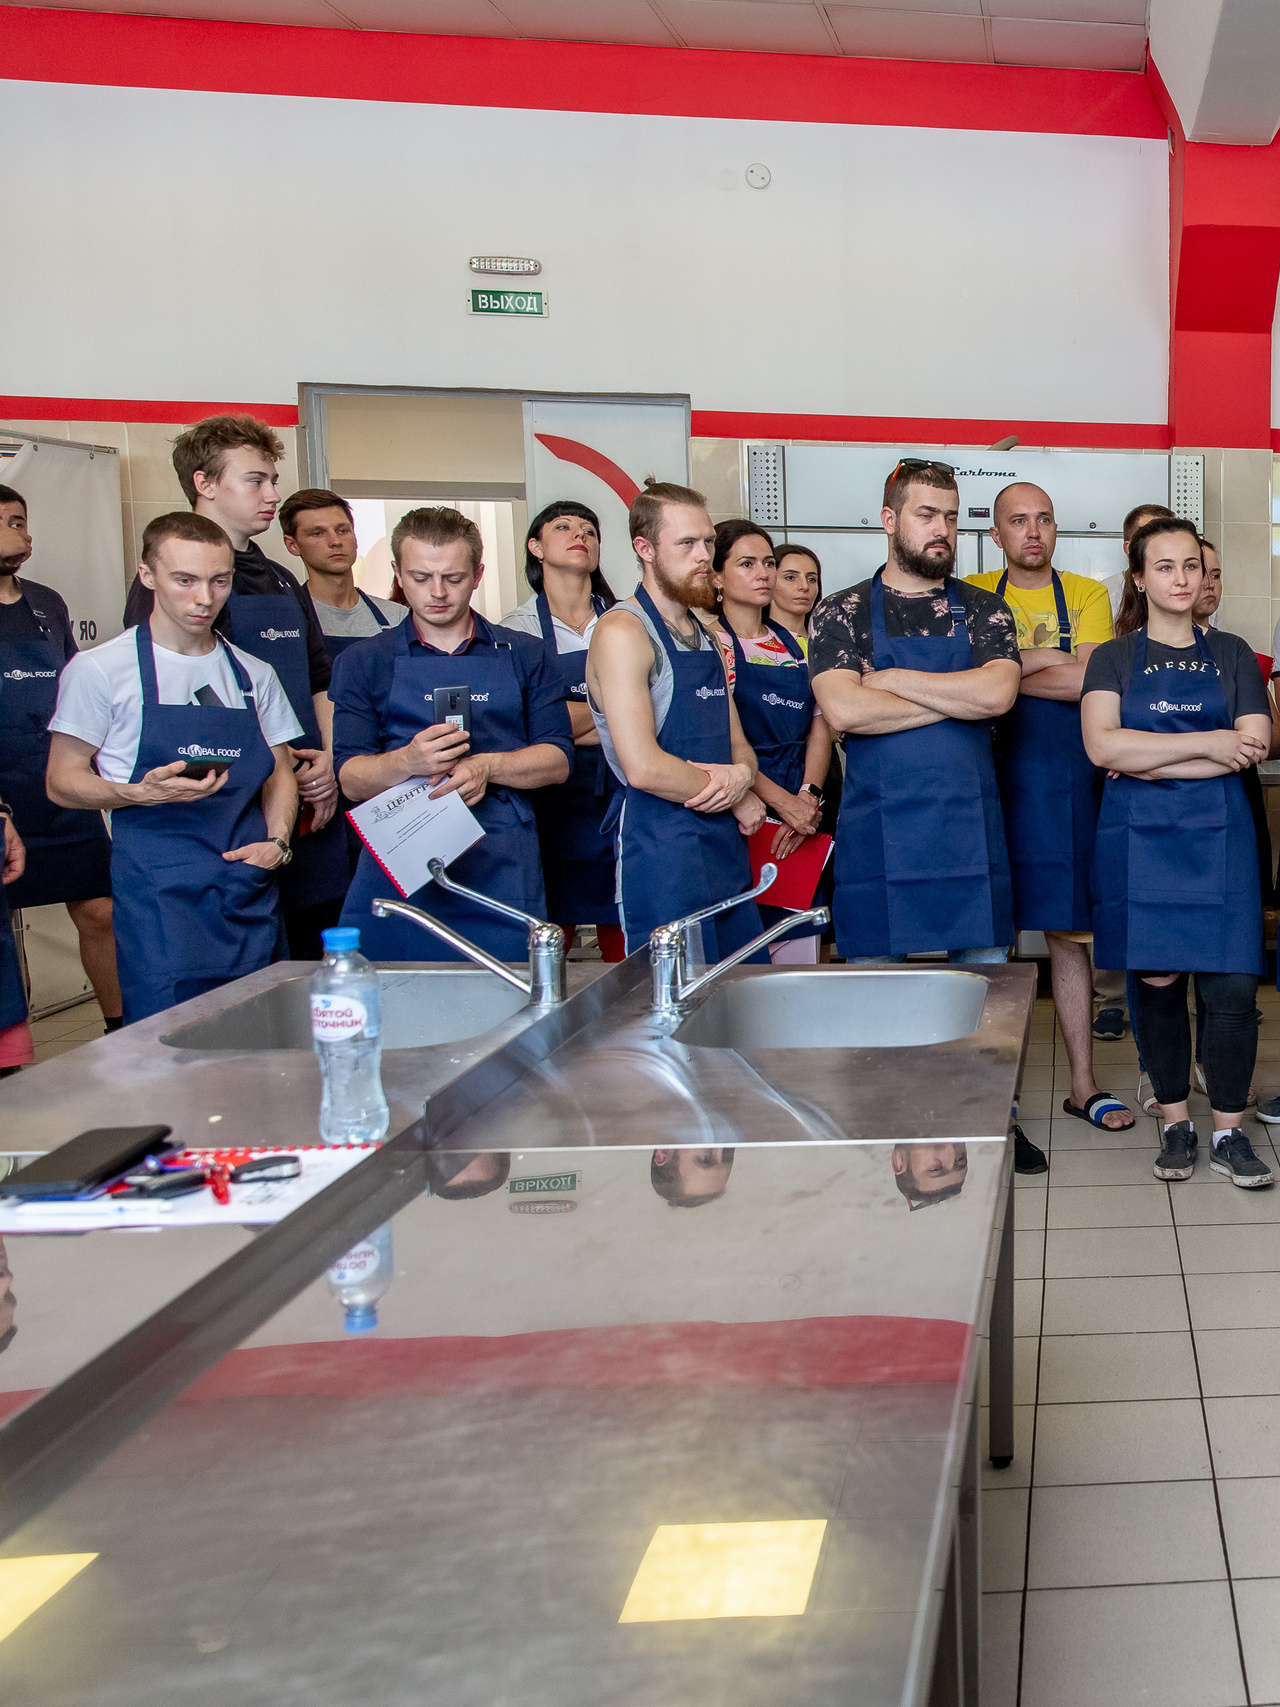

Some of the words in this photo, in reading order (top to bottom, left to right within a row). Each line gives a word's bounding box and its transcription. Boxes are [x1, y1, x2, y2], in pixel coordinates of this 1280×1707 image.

[478, 294, 538, 312] ВЫХОД
[284, 629, 300, 638] FOODS
[4, 669, 35, 680] GLOBAL
[35, 670, 57, 678] FOODS
[786, 700, 804, 709] FOODS
[1150, 700, 1180, 713] GLOBAL
[1181, 703, 1202, 711] FOODS
[177, 743, 217, 757] GLOBAL
[217, 748, 241, 758] FOODS
[386, 783, 429, 811] ЦЕНТР
